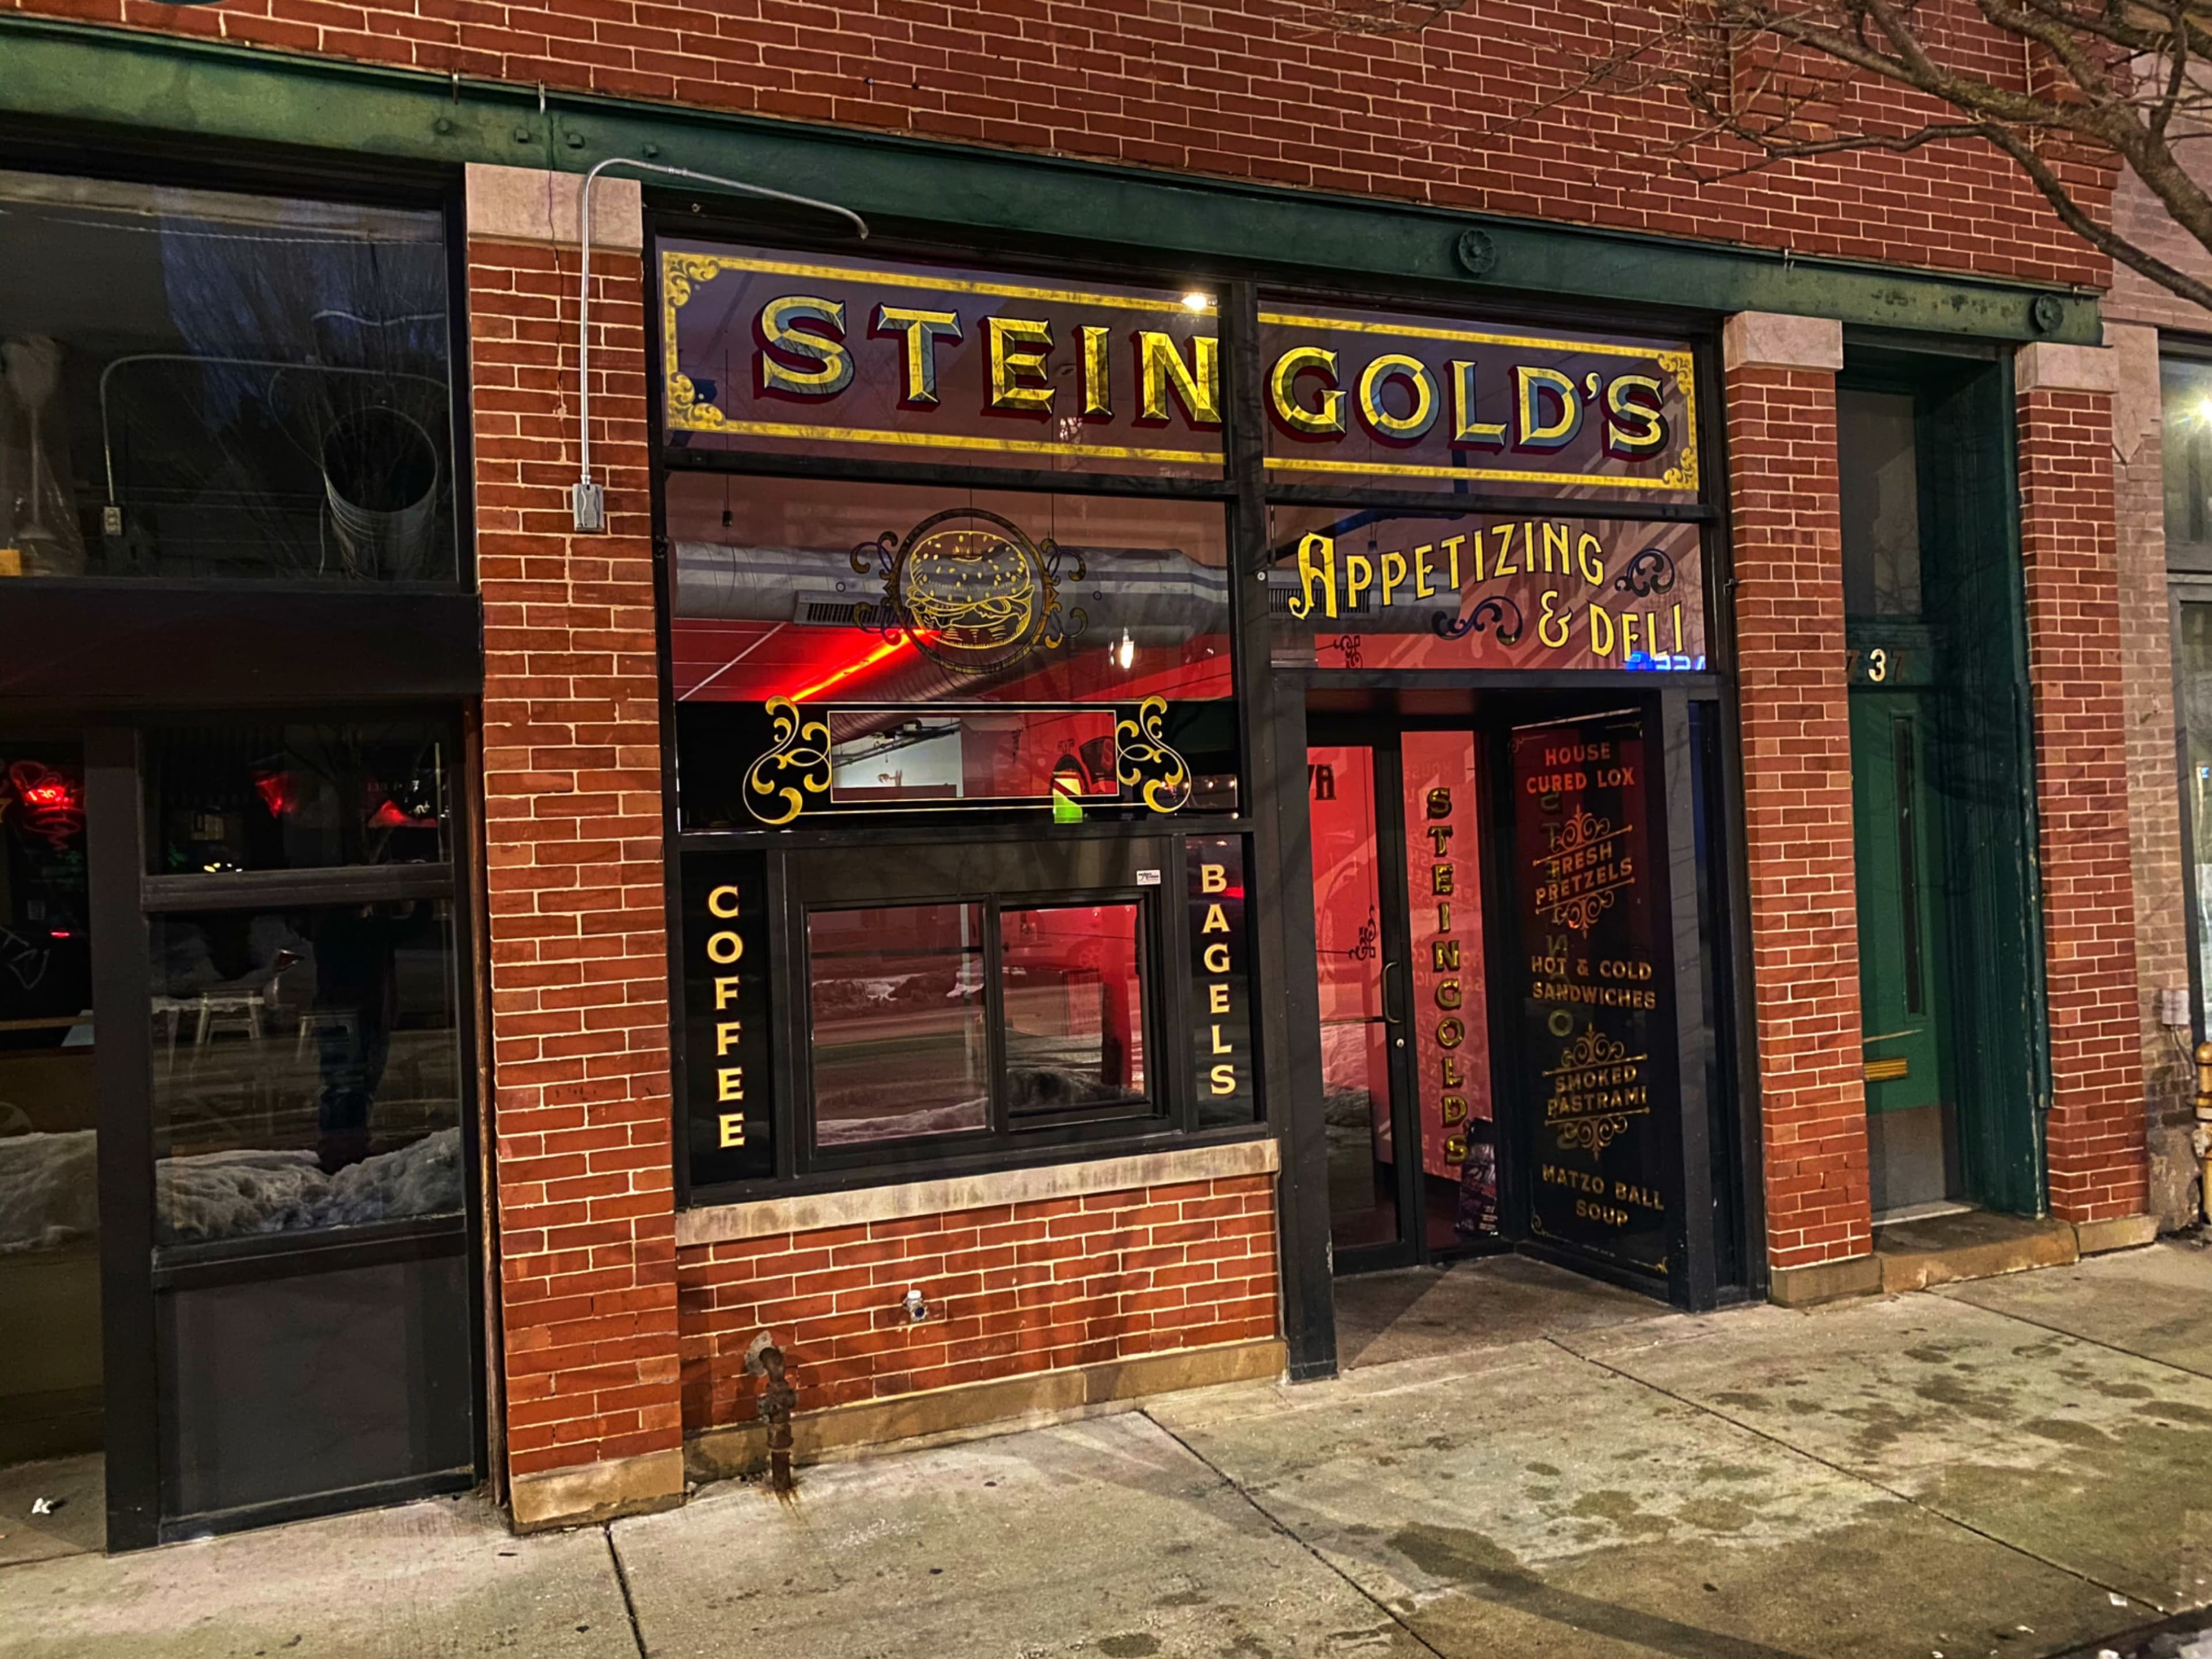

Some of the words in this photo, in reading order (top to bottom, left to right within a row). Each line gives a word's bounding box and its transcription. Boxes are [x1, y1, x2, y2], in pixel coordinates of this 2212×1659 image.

[1537, 590, 1574, 649] &
[1588, 601, 1684, 662] DELI
[1545, 743, 1611, 766] HOUSE
[1526, 772, 1588, 794] CURED
[1597, 767, 1636, 788] LOX
[1551, 842, 1612, 878] FRESH
[1536, 858, 1633, 905] PRETZELS
[1200, 863, 1236, 1094] BAGELS
[1531, 956, 1566, 975] HOT
[1577, 959, 1589, 976] &
[1600, 960, 1652, 979] COLD
[1532, 982, 1656, 1009] SANDWICHES
[707, 885, 745, 1148] COFFEE
[1555, 1065, 1637, 1094] SMOKED
[1547, 1086, 1647, 1116] PASTRAMI
[1542, 1164, 1604, 1194] MATZO
[1615, 1182, 1664, 1210] BALL
[1575, 1199, 1628, 1228] SOUP
